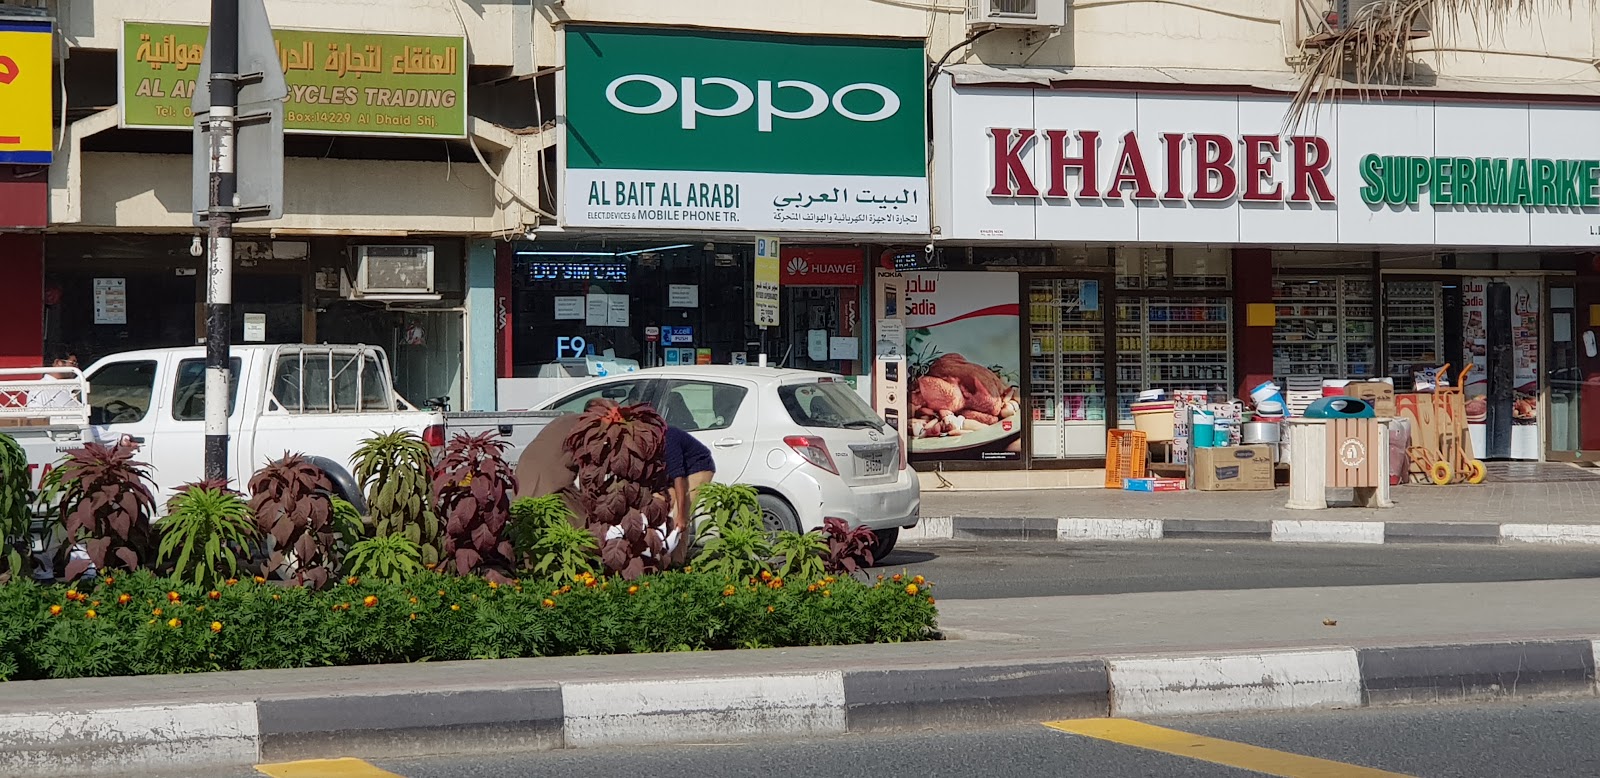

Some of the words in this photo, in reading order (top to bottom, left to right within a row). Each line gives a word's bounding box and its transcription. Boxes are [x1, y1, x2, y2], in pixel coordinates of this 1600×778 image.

[325, 43, 382, 79] لتجارة
[391, 45, 456, 75] العنقاء
[135, 78, 165, 98] AL
[363, 87, 456, 107] TRADING
[155, 105, 176, 117] Tel:
[357, 114, 370, 124] Al
[376, 114, 411, 125] Dhaid
[417, 115, 438, 128] Shj.
[986, 127, 1336, 202] KHAIBER
[1359, 153, 1600, 207] SUPERMARKE
[588, 181, 610, 206] AL
[616, 181, 656, 207] BAIT
[660, 182, 682, 207] AL
[687, 183, 740, 209] ARABI
[773, 187, 848, 212] العربي
[856, 188, 917, 210] البيت
[587, 211, 631, 220] ELECT.DEVICES
[637, 210, 680, 221] MOBILE
[682, 210, 721, 222] PHONE
[723, 211, 740, 222] TR.
[773, 212, 801, 223] المتحركة
[802, 212, 832, 224] والهواتف
[834, 212, 868, 225] الكهربائية
[896, 214, 918, 225] لتجارة
[562, 266, 590, 279] SIM
[811, 264, 856, 273] HUAWEI
[848, 300, 856, 332] LAVA
[556, 336, 586, 358] F9
